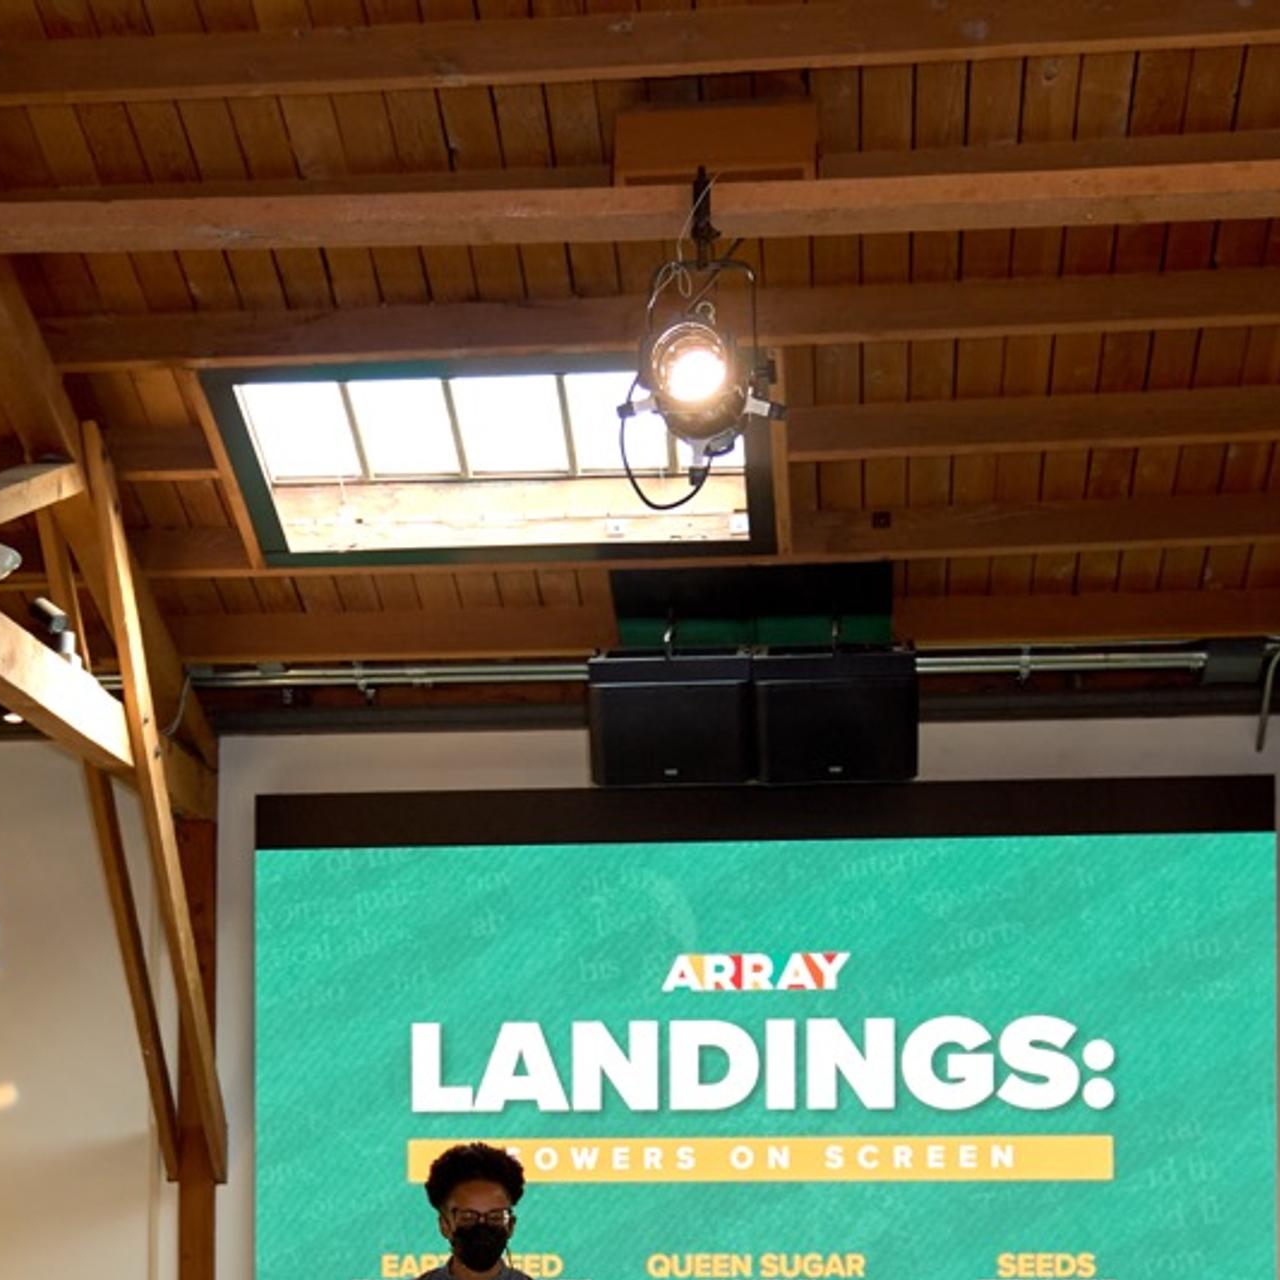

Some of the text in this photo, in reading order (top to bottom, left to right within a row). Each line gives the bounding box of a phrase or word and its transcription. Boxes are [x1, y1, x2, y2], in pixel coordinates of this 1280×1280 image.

[661, 952, 851, 992] ARRAY
[411, 1015, 1116, 1112] LANDINGS:
[729, 1145, 790, 1169] ON
[825, 1144, 1015, 1169] SCREEN
[646, 1252, 866, 1278] QUEEN SUGAR
[997, 1252, 1097, 1278] SEEDS
